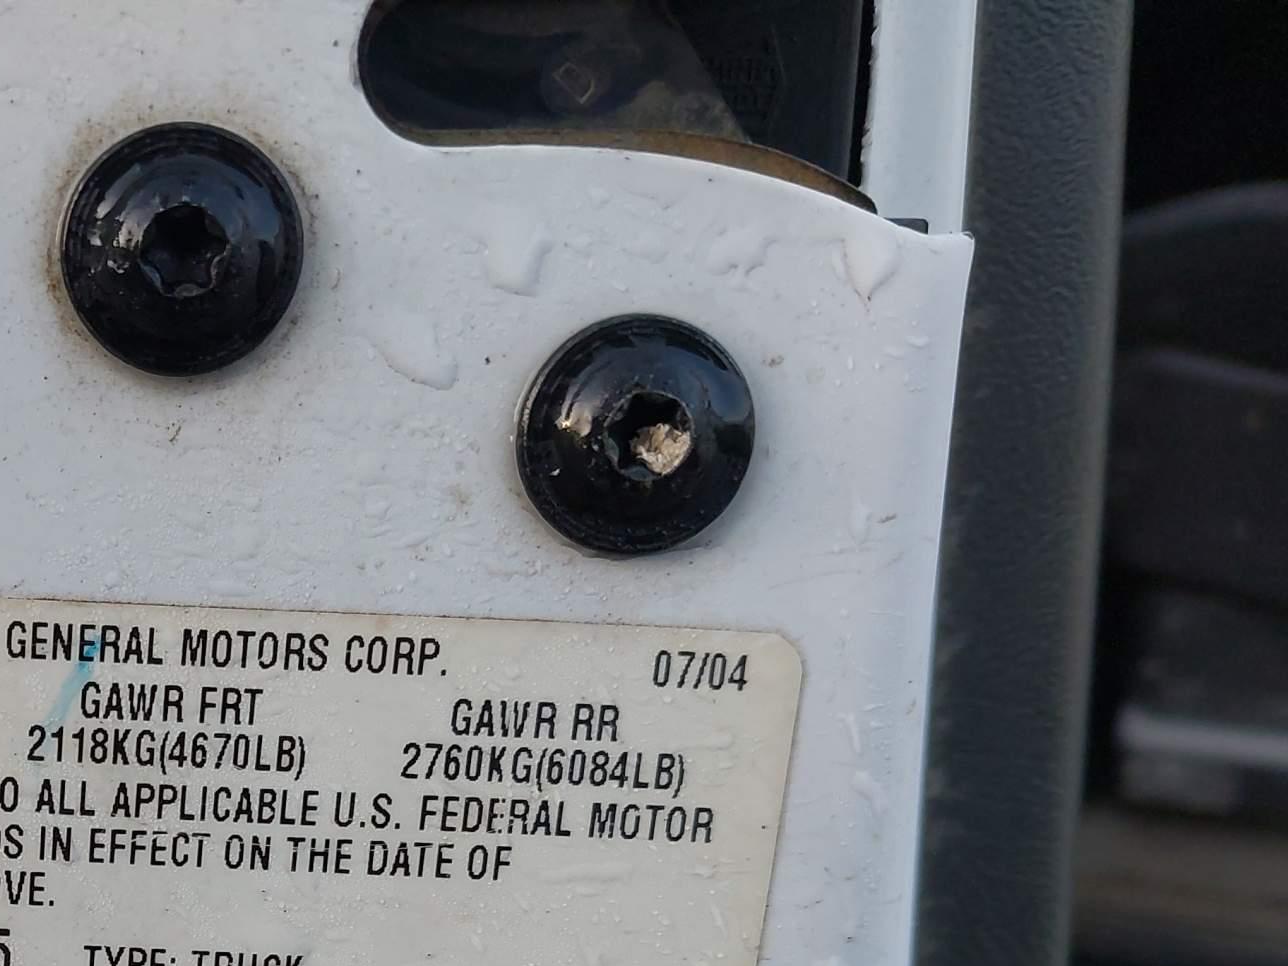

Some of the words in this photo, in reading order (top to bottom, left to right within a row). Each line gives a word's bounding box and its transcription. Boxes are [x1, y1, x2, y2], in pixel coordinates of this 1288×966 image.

[6, 620, 164, 668] GENERAL
[180, 628, 330, 672] MOTORS
[344, 634, 447, 677] CORP.
[652, 649, 749, 692] 07/04
[80, 680, 184, 723] GAWR
[198, 686, 264, 726] FRT
[450, 698, 558, 740] GAWR
[570, 703, 620, 743] RR
[26, 724, 306, 782] 2118KG(4670LB)
[400, 742, 686, 800] 2760KG(6084LB)
[34, 778, 96, 817] ALL
[110, 781, 320, 827] APPLICABLE
[333, 791, 401, 830] U.S.
[418, 794, 572, 838] FEDERAL
[587, 802, 715, 844] MOTOR
[39, 825, 73, 863] IN
[88, 827, 212, 868] EFFECT
[223, 834, 272, 871] ON
[286, 836, 354, 875] THE
[366, 839, 455, 879] DATE
[466, 844, 513, 881] OF
